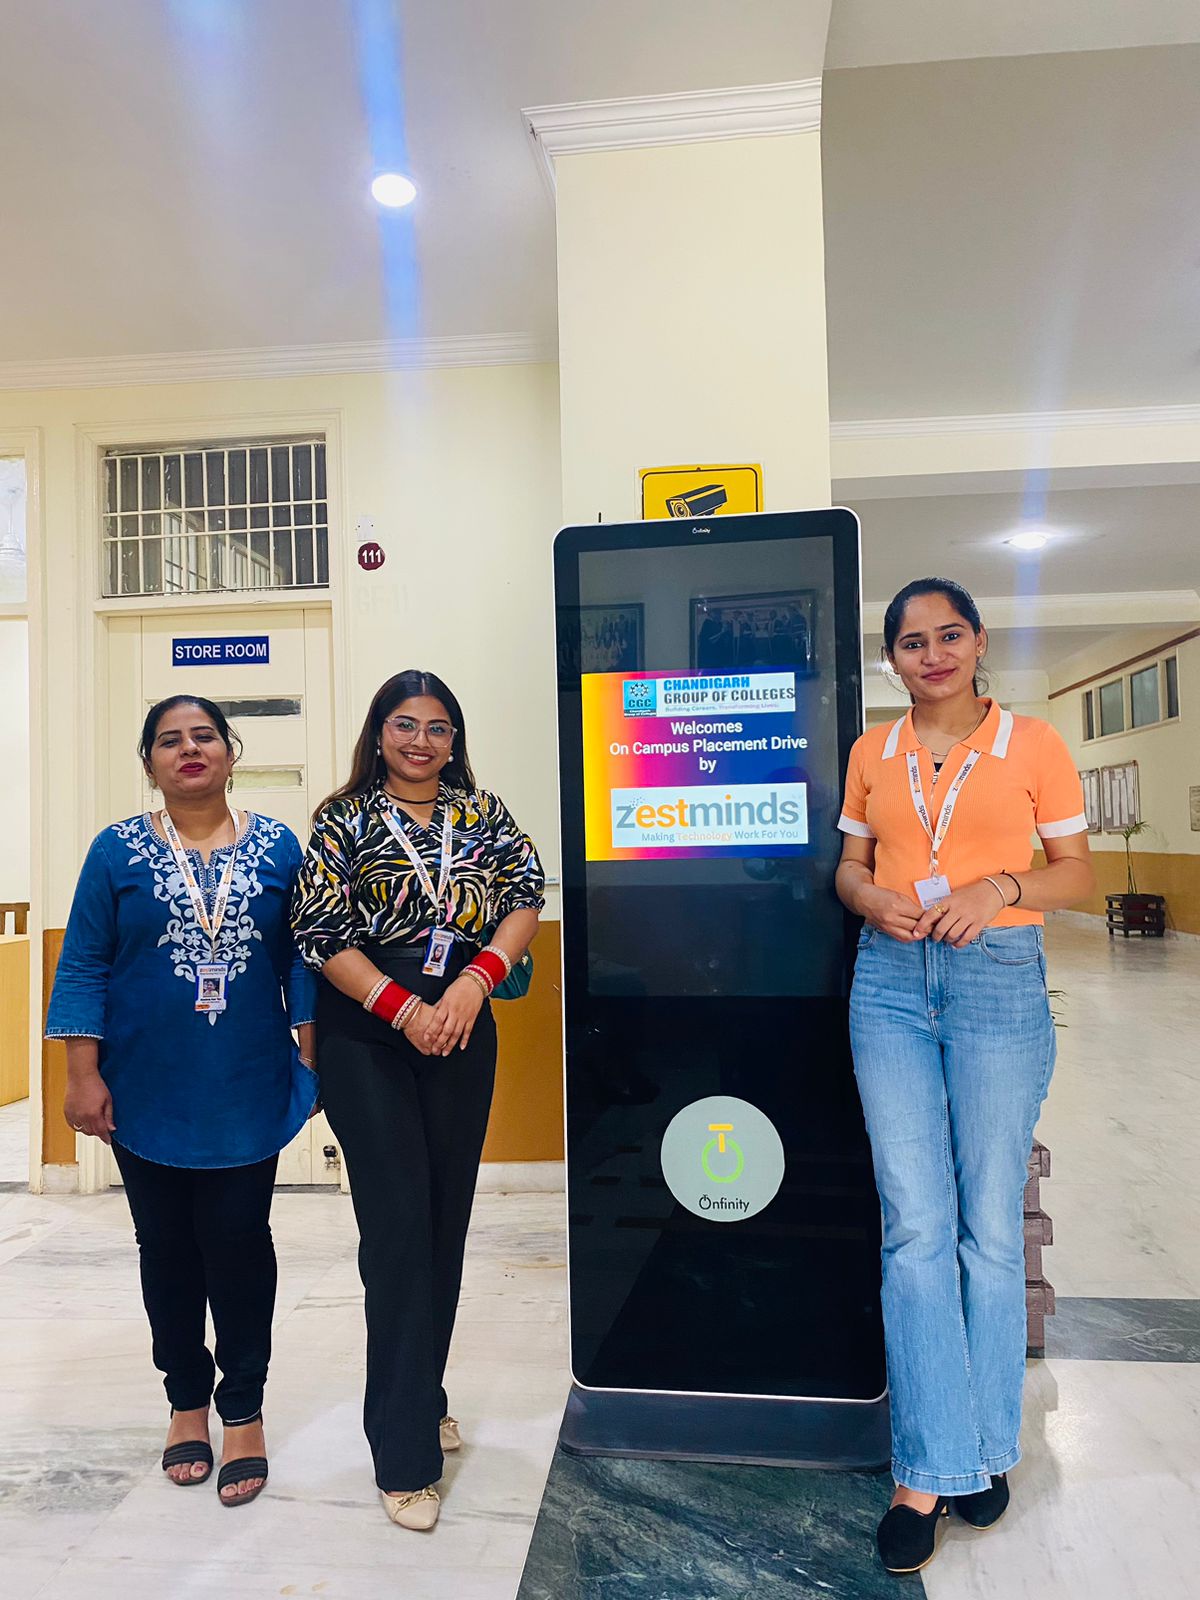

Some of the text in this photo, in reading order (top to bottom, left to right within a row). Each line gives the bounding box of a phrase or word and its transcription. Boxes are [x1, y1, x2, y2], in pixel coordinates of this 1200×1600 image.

[362, 549, 382, 563] 111
[175, 643, 267, 659] STORE ROOM
[664, 676, 750, 691] CHANDIGARH
[628, 699, 652, 708] CGC
[664, 688, 795, 704] GROUP OF COLLEGES
[670, 721, 743, 735] Welcomes
[609, 735, 808, 757] On Campus Placement Drive
[699, 757, 717, 773] by
[616, 792, 799, 829] zestminds
[642, 828, 799, 843] Making Technology Work For You
